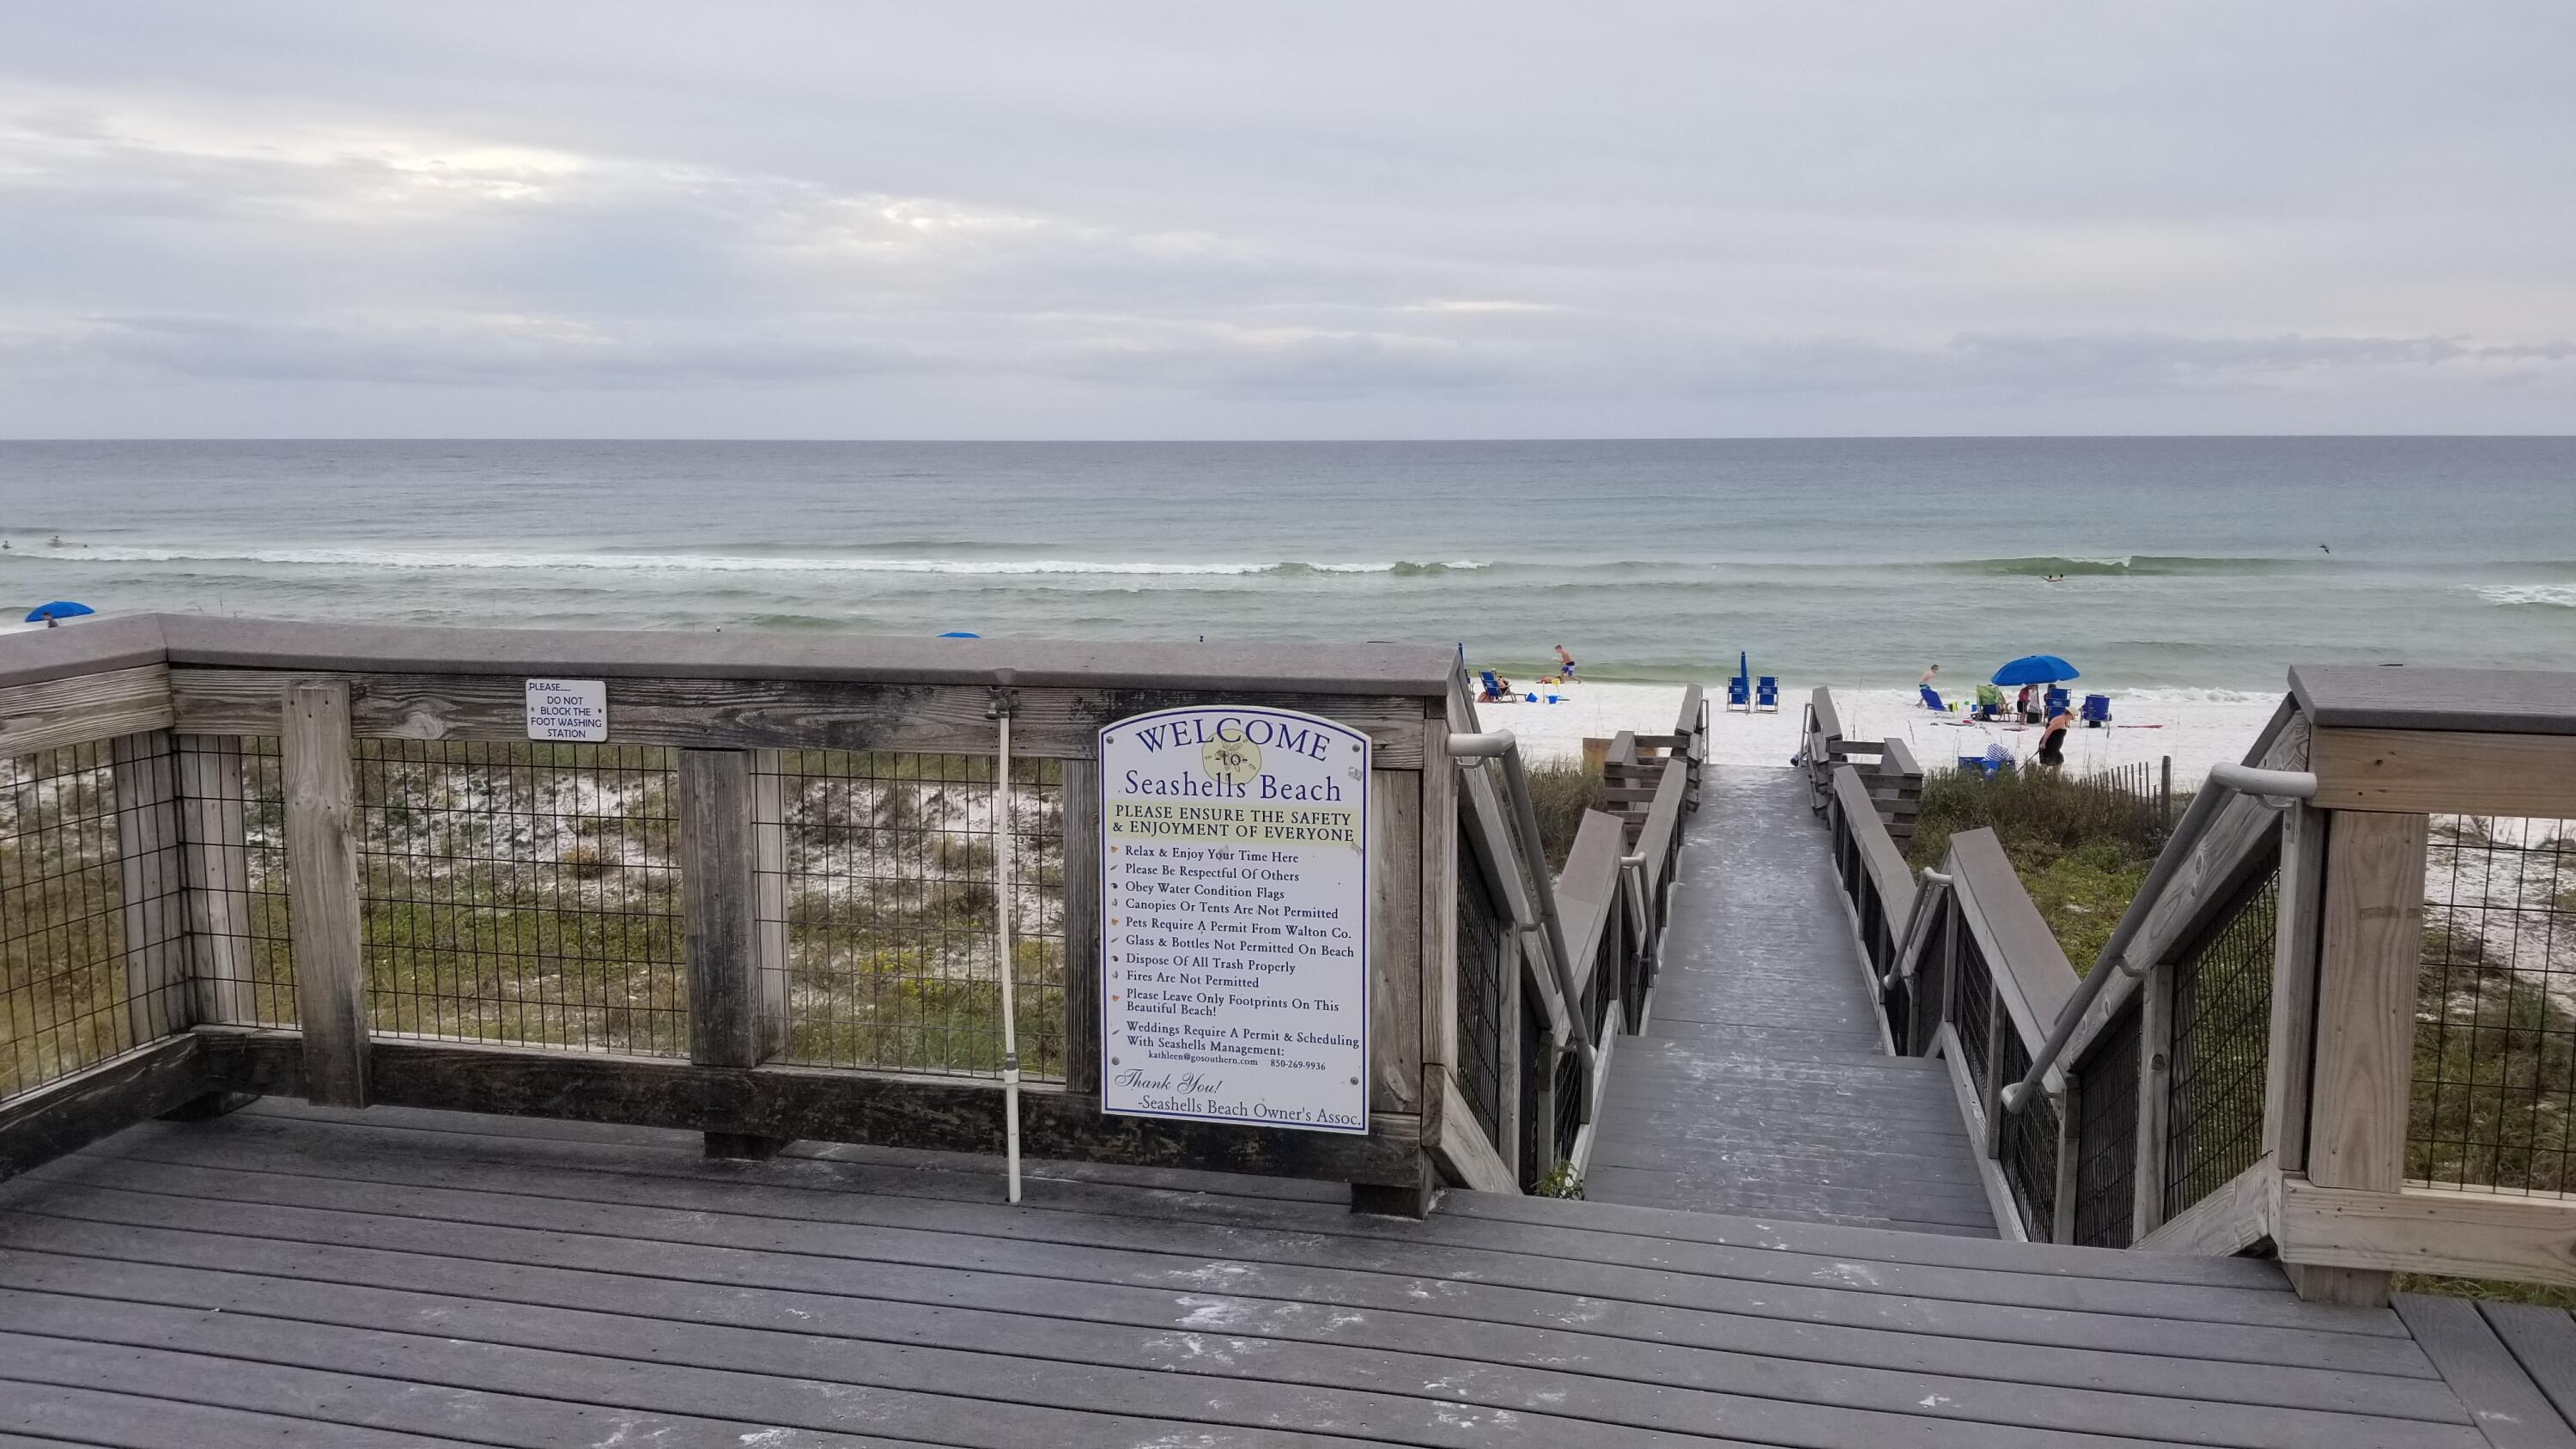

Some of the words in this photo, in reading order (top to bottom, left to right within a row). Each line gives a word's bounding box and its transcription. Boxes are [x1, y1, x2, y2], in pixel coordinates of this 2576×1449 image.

[540, 706, 571, 715] BLOCK
[573, 708, 592, 716] THE
[547, 696, 562, 704] DO
[563, 697, 584, 705] NOT
[531, 717, 556, 726] FOOT
[557, 718, 602, 728] WASHING
[548, 728, 586, 738] STATION
[1134, 716, 1331, 762] WELCOME
[1125, 770, 1246, 799] Seashells
[1260, 773, 1342, 801] Beach
[1115, 804, 1173, 819] PLEASE
[1180, 807, 1244, 822] ENSURE
[1250, 810, 1285, 824] THE
[1291, 811, 1352, 825] SAFETY
[1112, 821, 1123, 832] &
[1129, 820, 1230, 837] ENJOYMENT
[1236, 825, 1258, 837] OF
[1264, 825, 1354, 842] EVERYONE
[1126, 844, 1155, 857] Relax
[1159, 849, 1168, 857] &
[1172, 847, 1205, 861] Enjoy
[1207, 849, 1235, 861] Your
[1238, 849, 1267, 861] Time
[1272, 851, 1299, 863] Here
[1126, 862, 1158, 875] Please
[1162, 865, 1176, 876] Be
[1179, 865, 1237, 880] Respectful
[1242, 868, 1259, 880] Of
[1261, 869, 1300, 881] Others
[1125, 880, 1154, 895] Obey
[1157, 882, 1191, 894] Water
[1194, 884, 1252, 898] Condition
[1256, 887, 1285, 901] Flags
[1126, 898, 1176, 913] Canopies
[1180, 901, 1196, 911] Or
[1200, 901, 1230, 914] Tents
[1233, 904, 1254, 915] Are
[1257, 904, 1280, 916] Not
[1284, 906, 1339, 919] Permitted
[1126, 916, 1147, 928] Pets
[1151, 917, 1194, 932] Require
[1197, 921, 1206, 931] A
[1211, 921, 1248, 934] Permit
[1252, 922, 1281, 935] From
[1285, 924, 1327, 938] Walton
[1331, 927, 1352, 939] Co.
[1126, 934, 1155, 947] Glass
[1158, 938, 1168, 947] &
[1172, 936, 1210, 949] Bottles
[1213, 939, 1236, 951] Not
[1239, 941, 1295, 954] Permitted
[1298, 943, 1316, 955] On
[1321, 945, 1354, 958] Beach
[1126, 953, 1170, 967] Dispose
[1173, 955, 1189, 966] Of
[1192, 956, 1209, 968] All
[1212, 957, 1243, 970] Trash
[1248, 959, 1297, 975] Properly
[1127, 970, 1152, 982] Fires
[1157, 971, 1176, 983] Are
[1180, 973, 1202, 985] Not
[1206, 975, 1260, 988] Permitted
[1127, 988, 1159, 1000] Please
[1163, 990, 1193, 1002] Leave
[1196, 992, 1224, 1007] Only
[1229, 994, 1288, 1009] Footprints
[1291, 998, 1310, 1010] On
[1314, 999, 1340, 1012] This
[1127, 1001, 1176, 1014] Beautiful
[1181, 1004, 1217, 1017] Beach!
[1127, 1020, 1181, 1037] Weddings
[1183, 1024, 1227, 1038] Require
[1230, 1027, 1239, 1038] A
[1242, 1028, 1279, 1041] Permit
[1284, 1032, 1293, 1042] &
[1297, 1032, 1359, 1049] Scheduling
[1127, 1035, 1154, 1047] With
[1158, 1038, 1206, 1051] Seashells
[1210, 1040, 1285, 1056] Management:
[1148, 1050, 1259, 1066] kathleen@gosouthern.com
[1270, 1058, 1326, 1071] 850-269-9936
[1115, 1068, 1172, 1090] Thank
[1176, 1072, 1224, 1095] You!
[1207, 1099, 1248, 1117] Beach
[1254, 1103, 1311, 1122] Owner's
[1316, 1108, 1361, 1126] Assoc.
